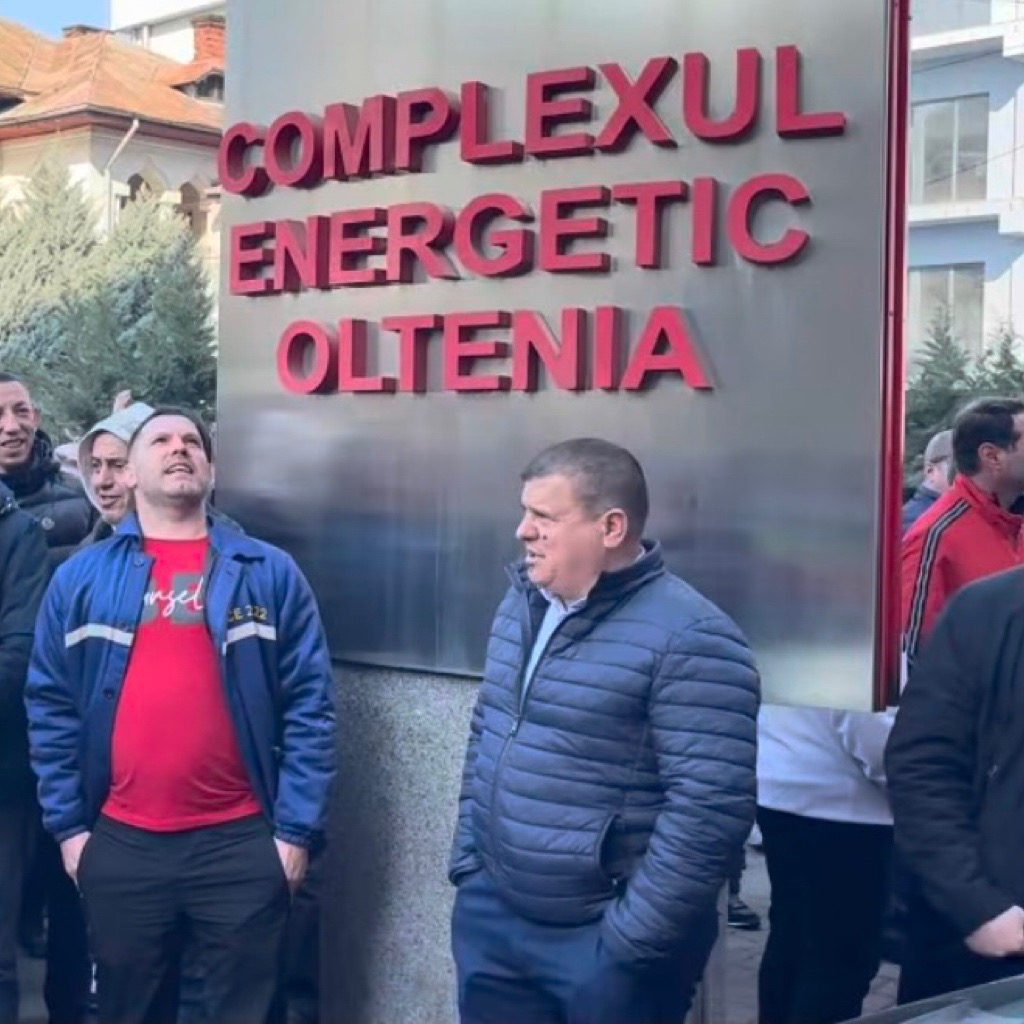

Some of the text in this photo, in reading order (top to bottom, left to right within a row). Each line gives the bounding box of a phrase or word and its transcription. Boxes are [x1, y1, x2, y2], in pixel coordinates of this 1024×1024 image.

[217, 44, 847, 198] COMPLEXUL
[229, 173, 811, 297] ENERGETIC
[276, 305, 713, 396] OLTENIA
